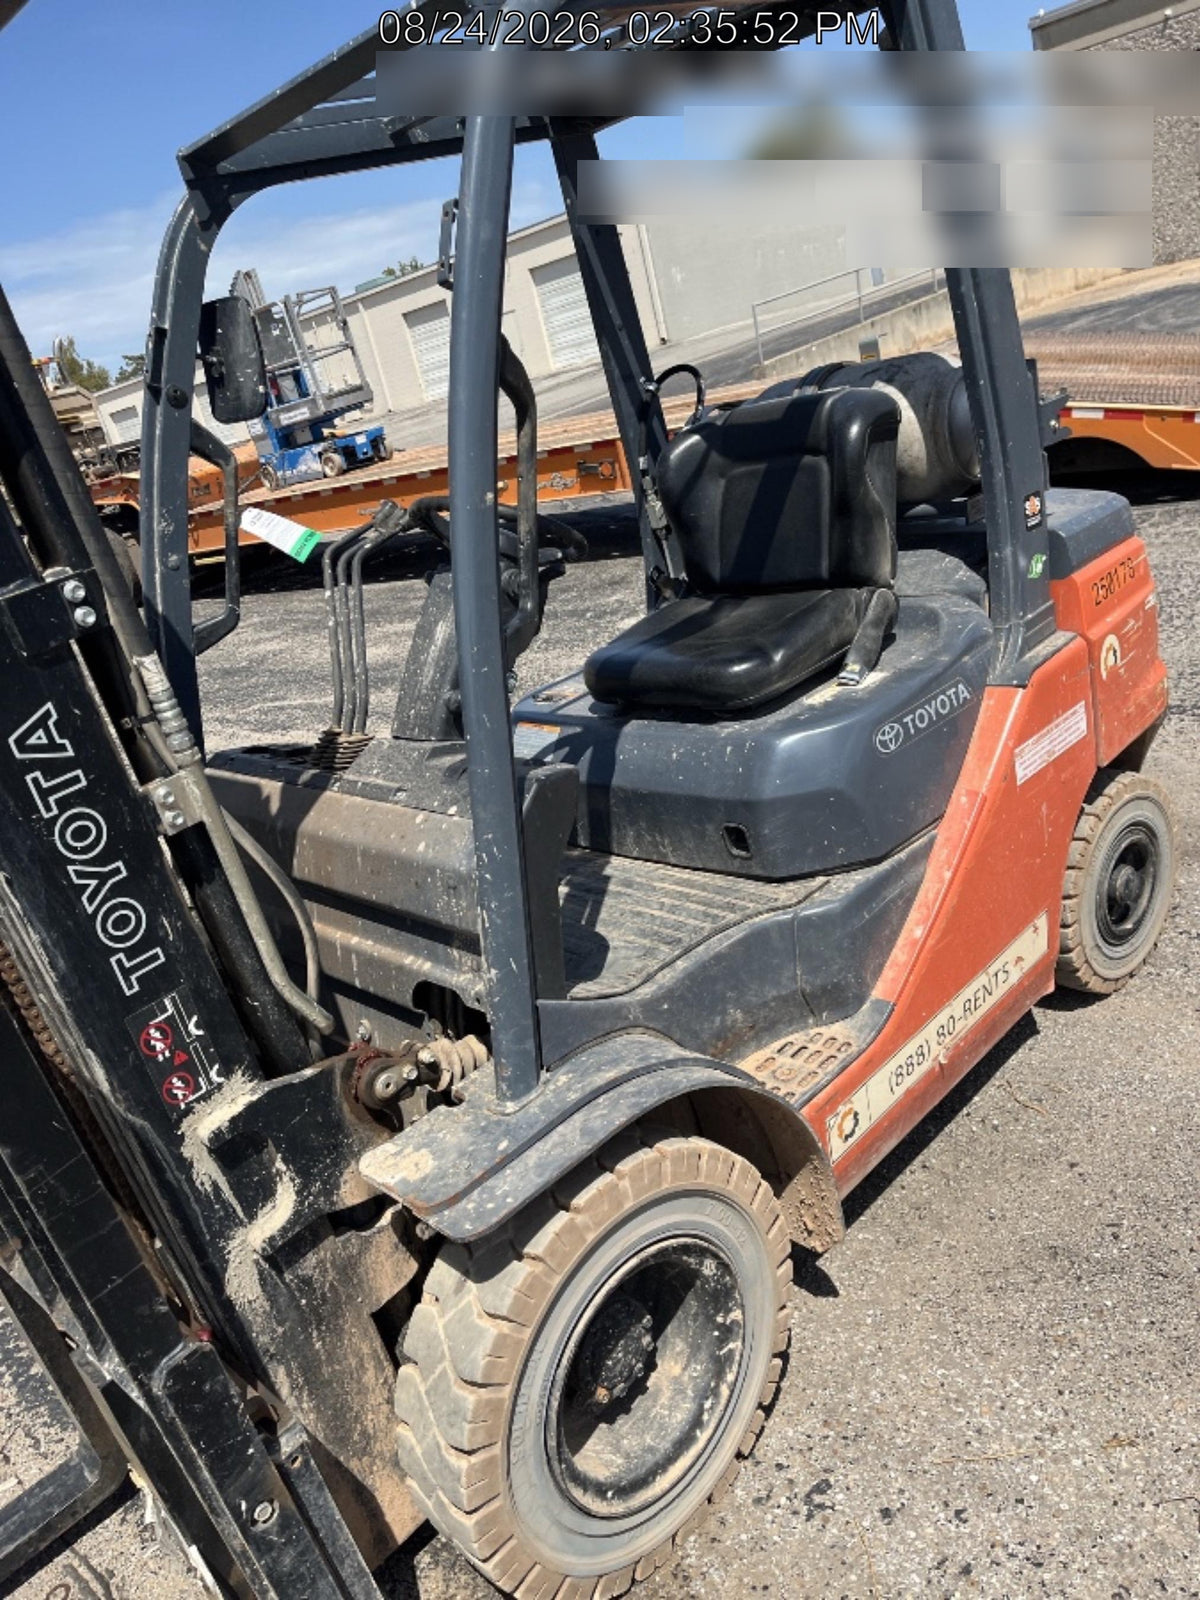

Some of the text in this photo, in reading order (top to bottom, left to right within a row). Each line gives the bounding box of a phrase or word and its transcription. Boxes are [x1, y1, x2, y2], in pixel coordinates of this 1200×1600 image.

[903, 683, 970, 735] TOYOTA
[8, 701, 166, 996] TOYOTA
[888, 961, 1010, 1095] (888) 80-RENTS
